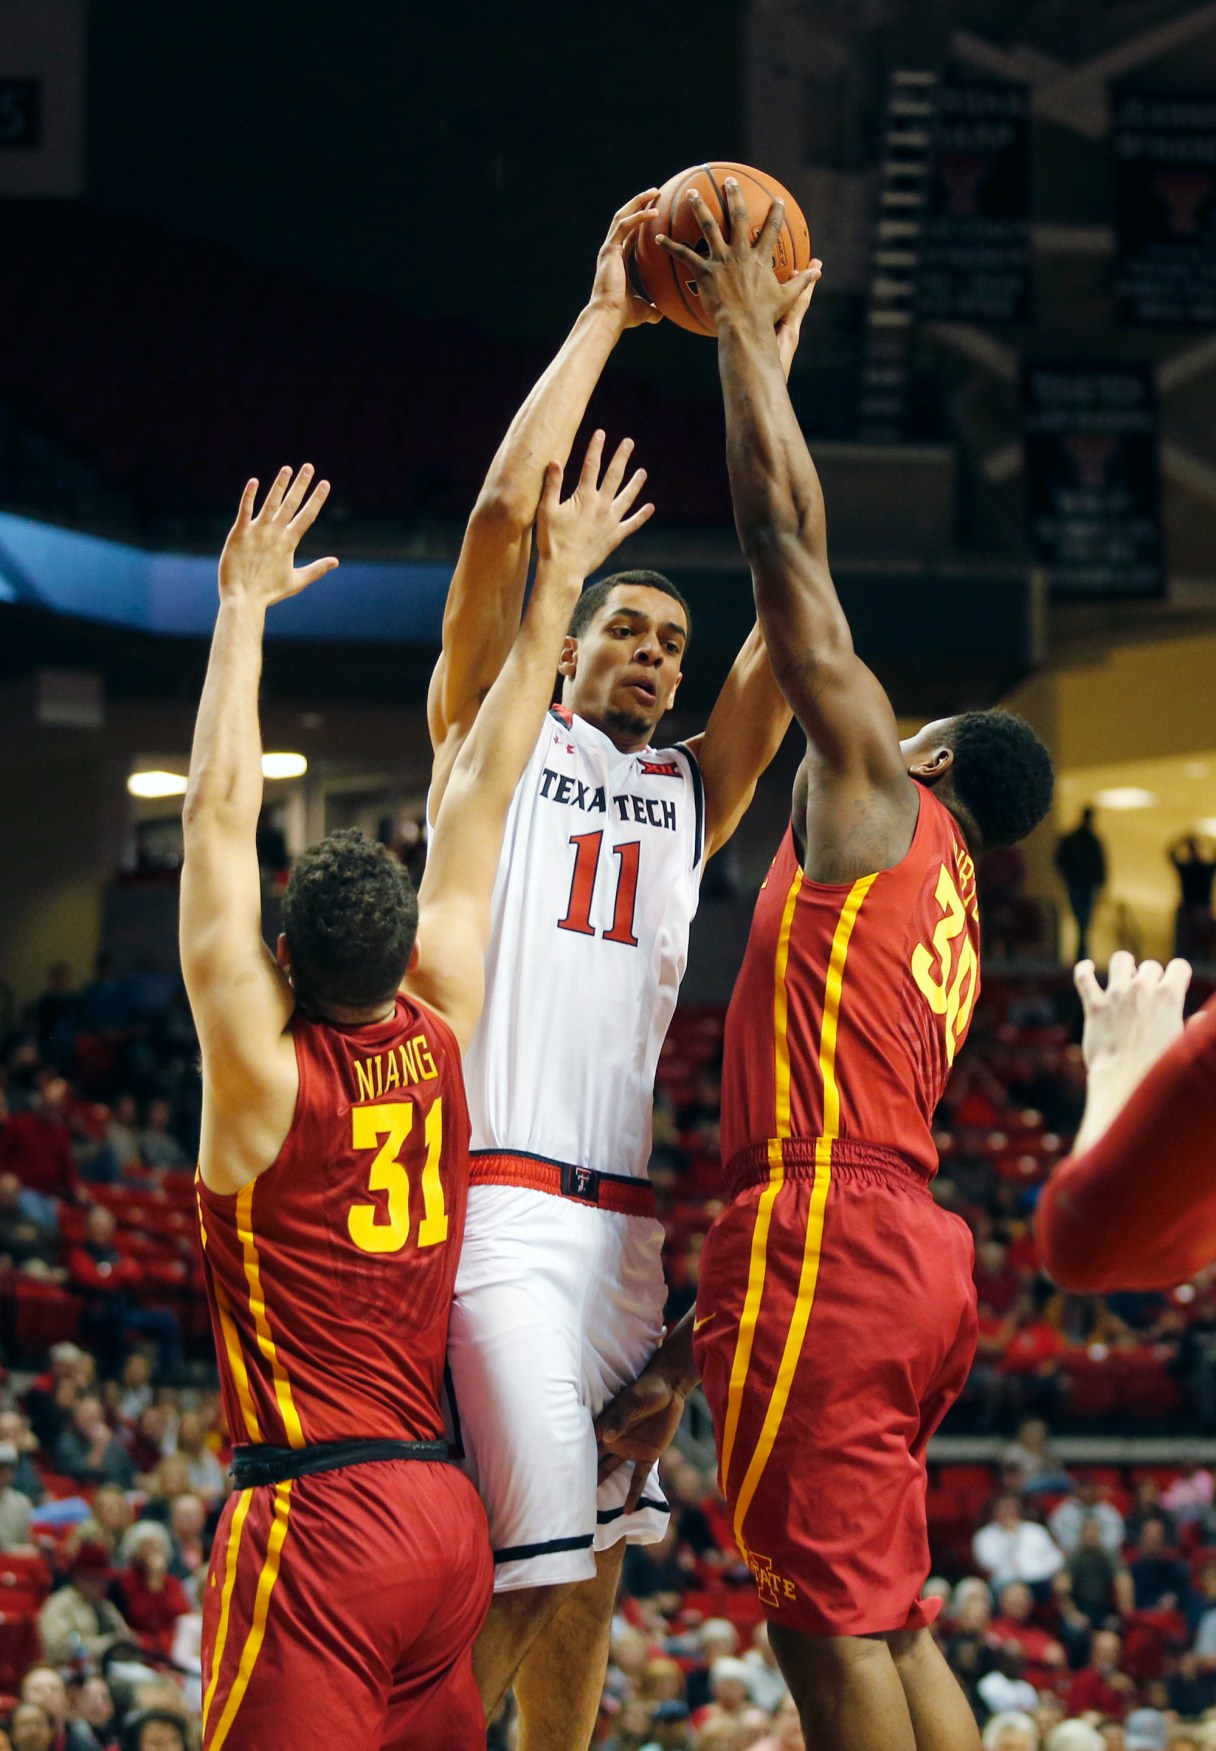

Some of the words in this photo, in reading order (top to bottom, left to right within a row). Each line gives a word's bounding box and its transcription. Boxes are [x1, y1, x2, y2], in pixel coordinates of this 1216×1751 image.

[539, 768, 608, 814] TEXA
[613, 794, 677, 832] TECH
[556, 829, 642, 948] 11
[911, 862, 978, 1068] 30
[354, 1034, 439, 1102] NIANG
[348, 1097, 448, 1253] 31
